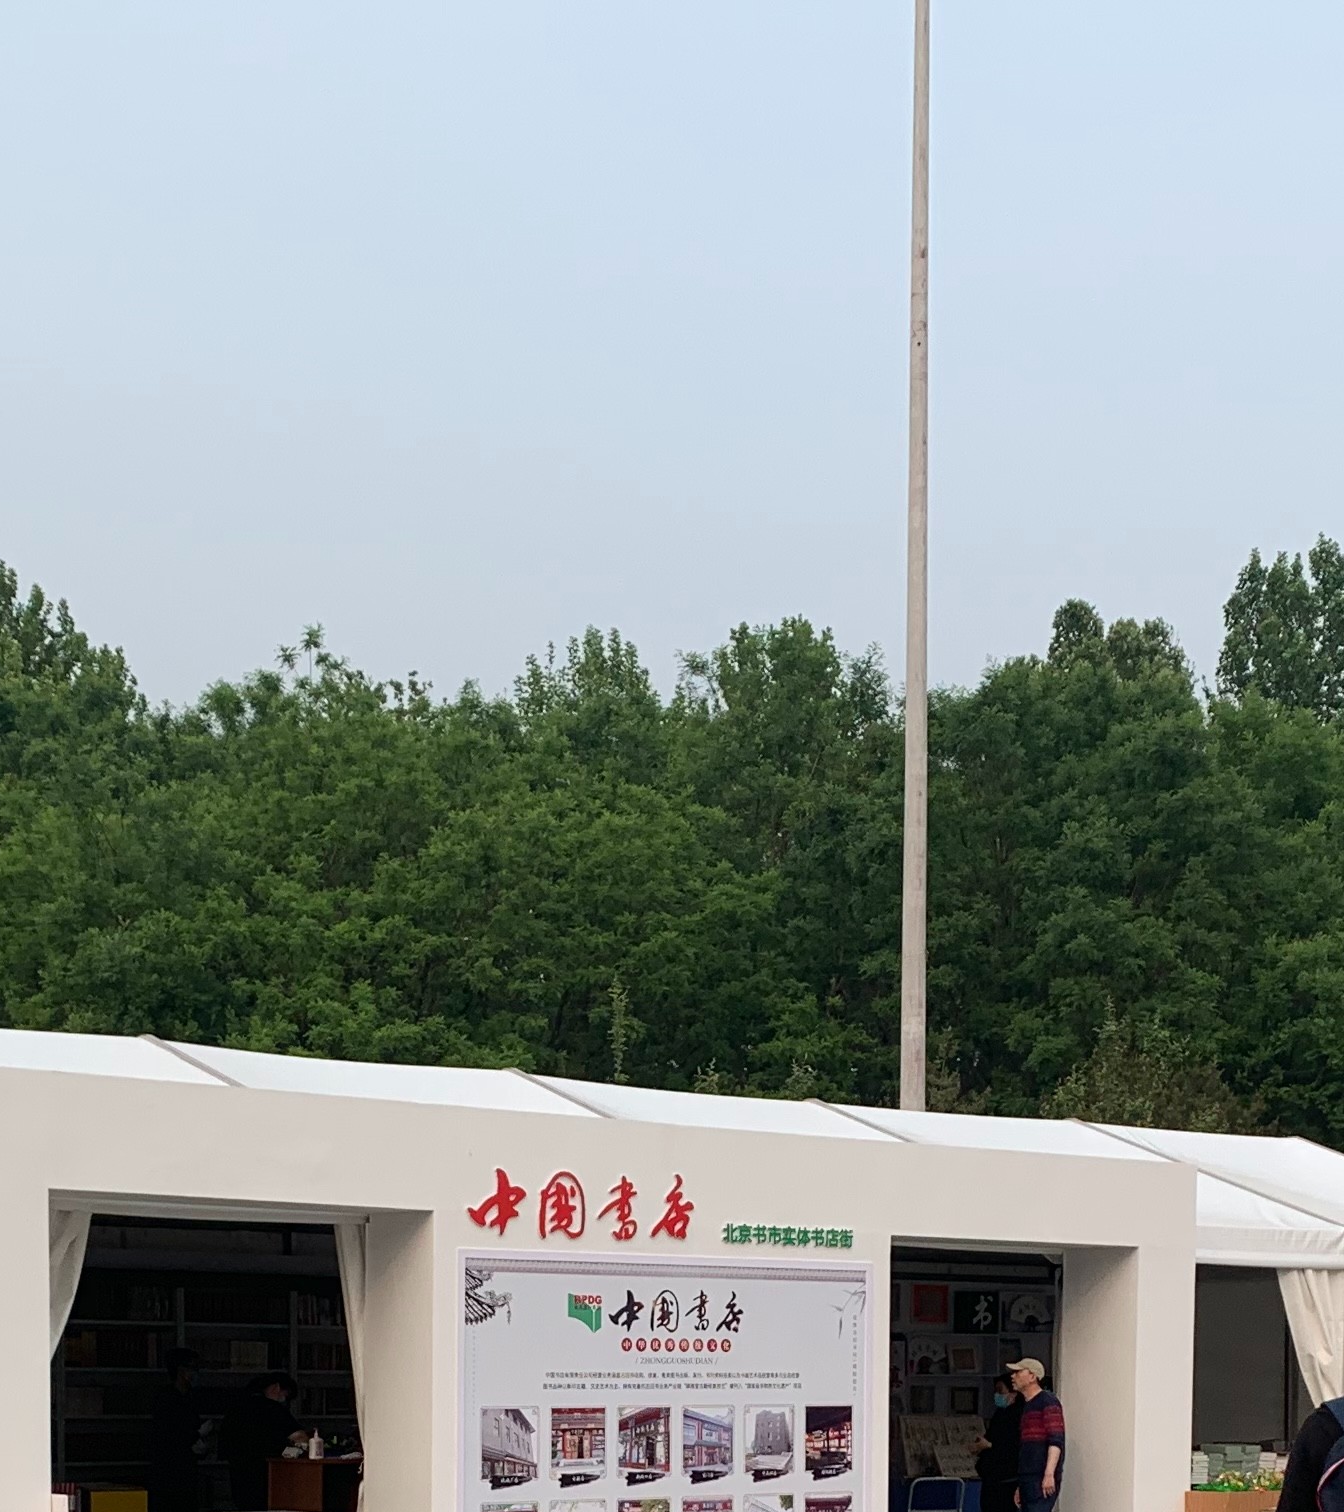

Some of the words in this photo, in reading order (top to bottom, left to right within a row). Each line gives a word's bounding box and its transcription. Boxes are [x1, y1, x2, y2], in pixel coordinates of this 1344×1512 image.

[722, 1223, 853, 1248] 北京书市实体书店街
